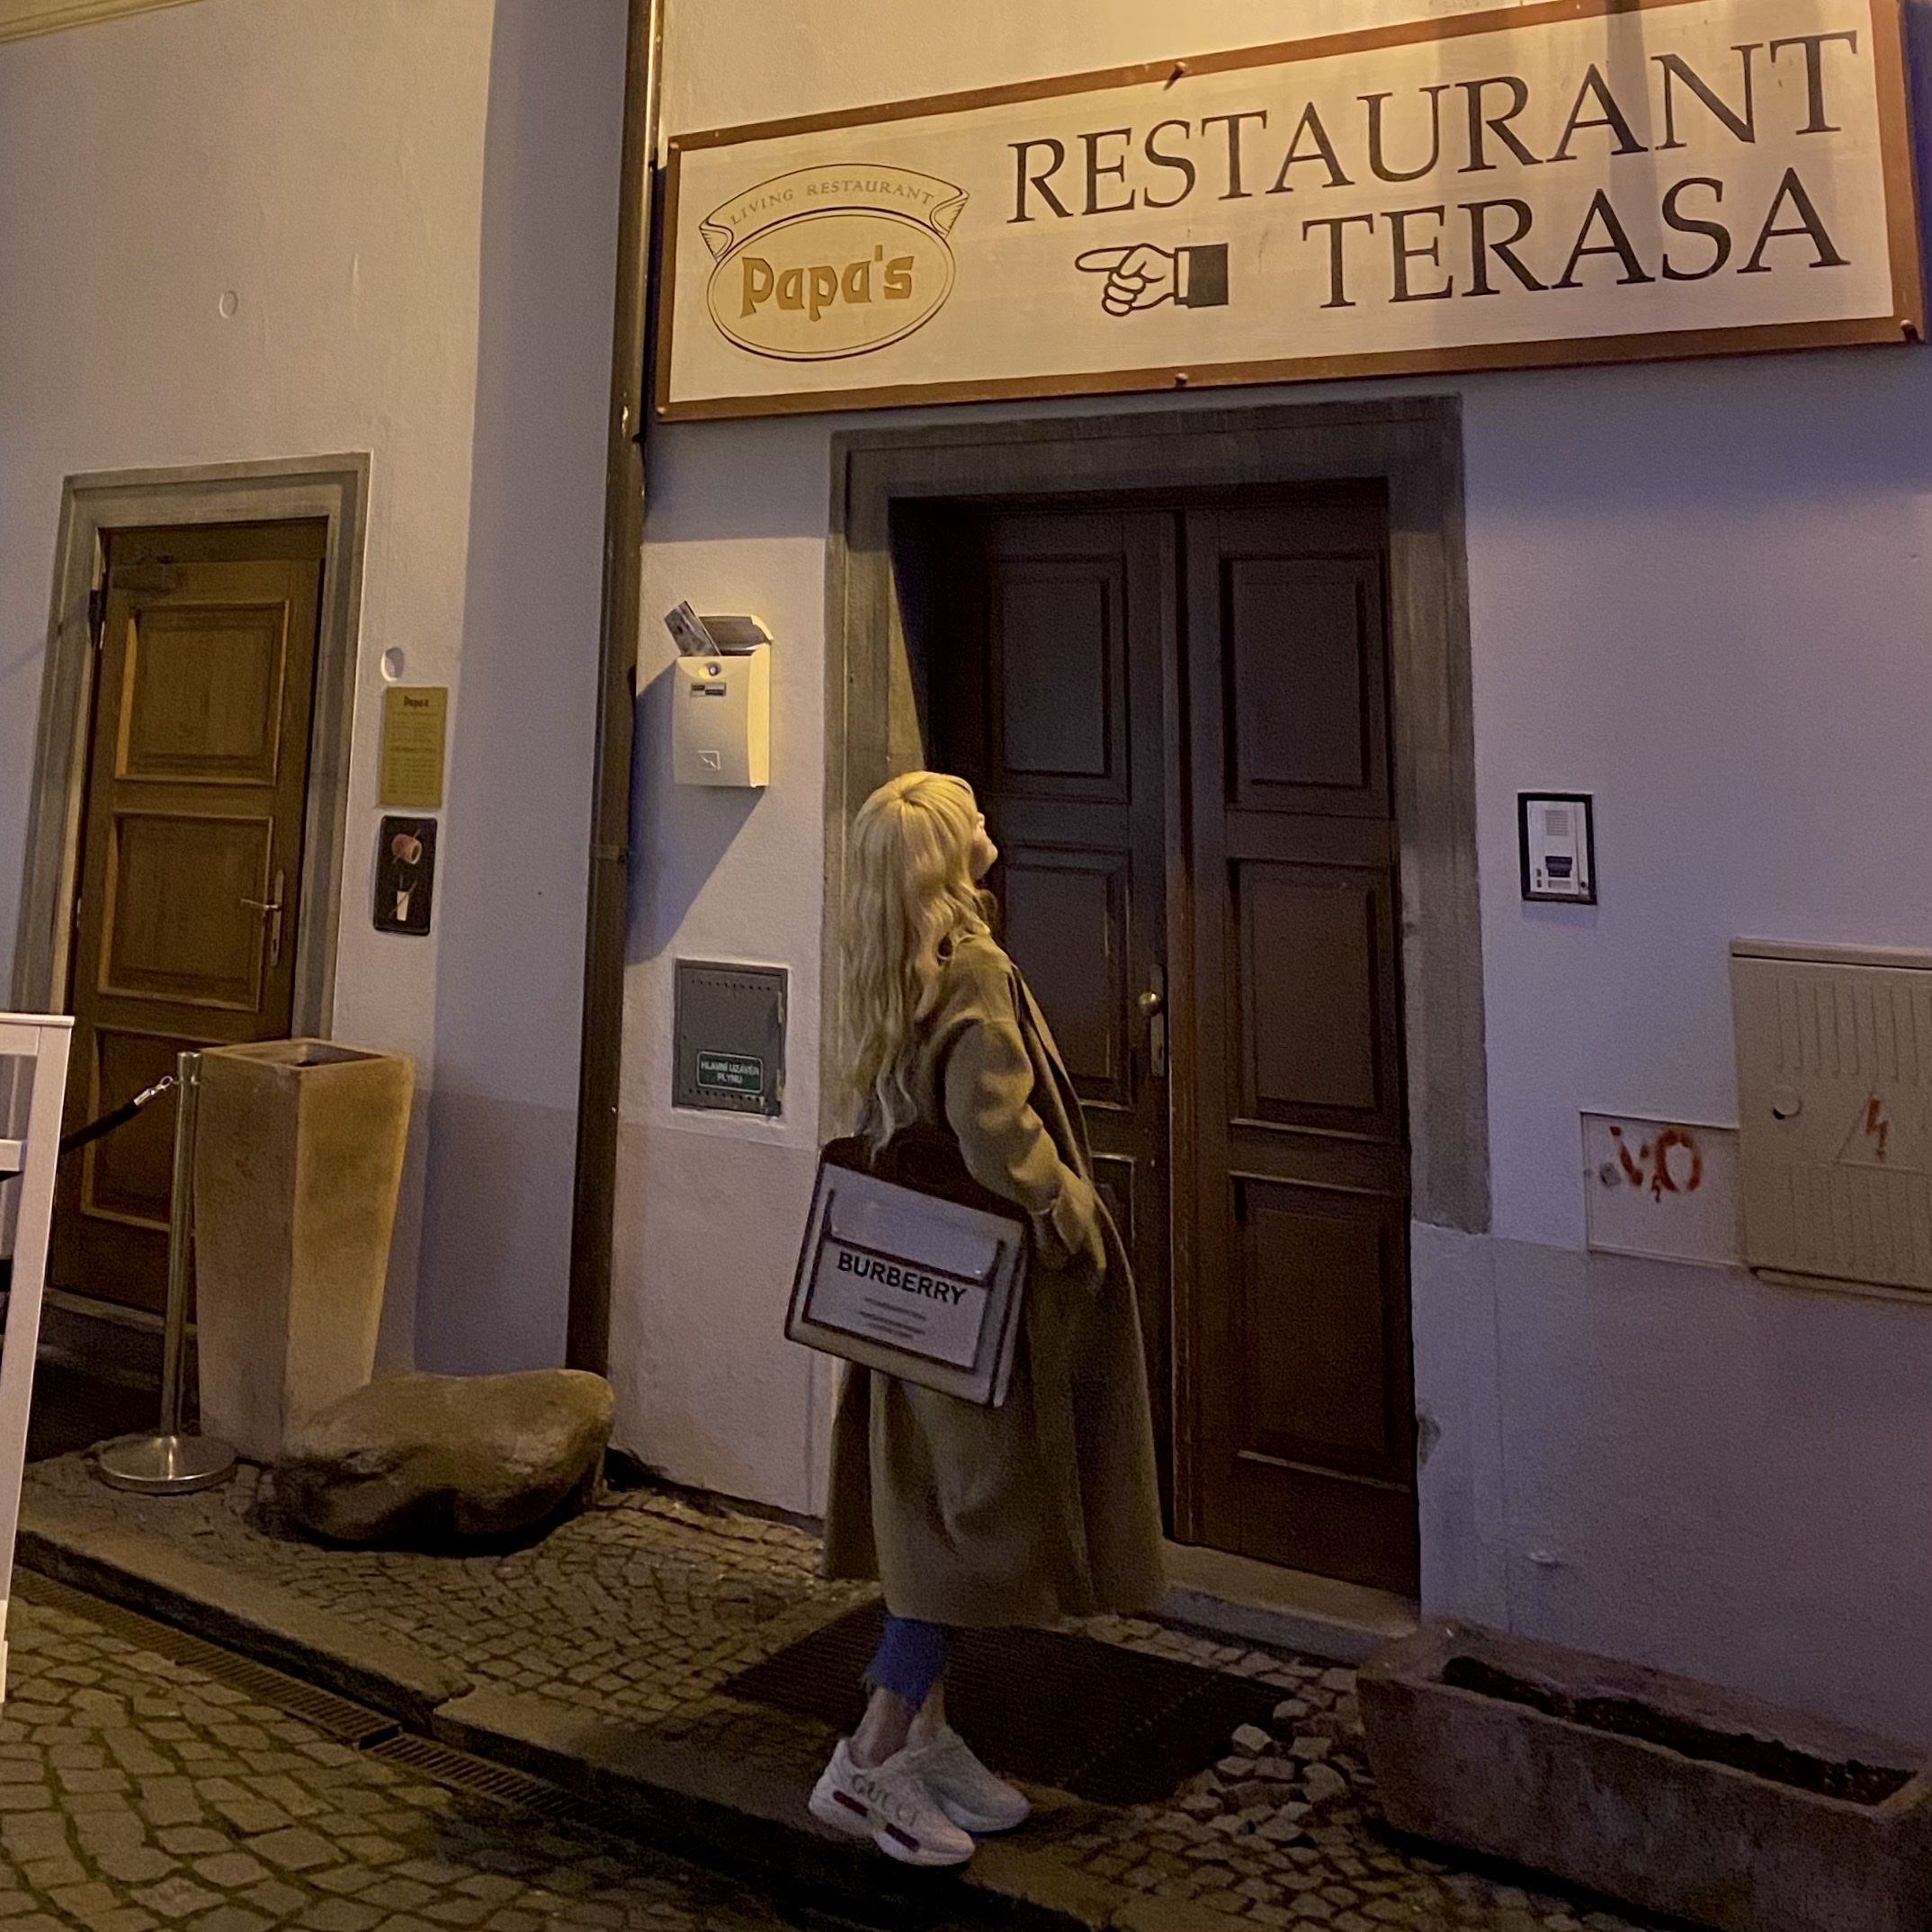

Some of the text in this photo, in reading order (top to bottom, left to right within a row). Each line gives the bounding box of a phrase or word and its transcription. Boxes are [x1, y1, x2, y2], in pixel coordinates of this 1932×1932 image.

[1006, 31, 1857, 225] RESTAURANT
[730, 180, 935, 226] LIVING RESTAURANT
[1302, 165, 1851, 310] TERASA
[739, 245, 915, 322] Papa's
[836, 1251, 967, 1305] BURBERRY
